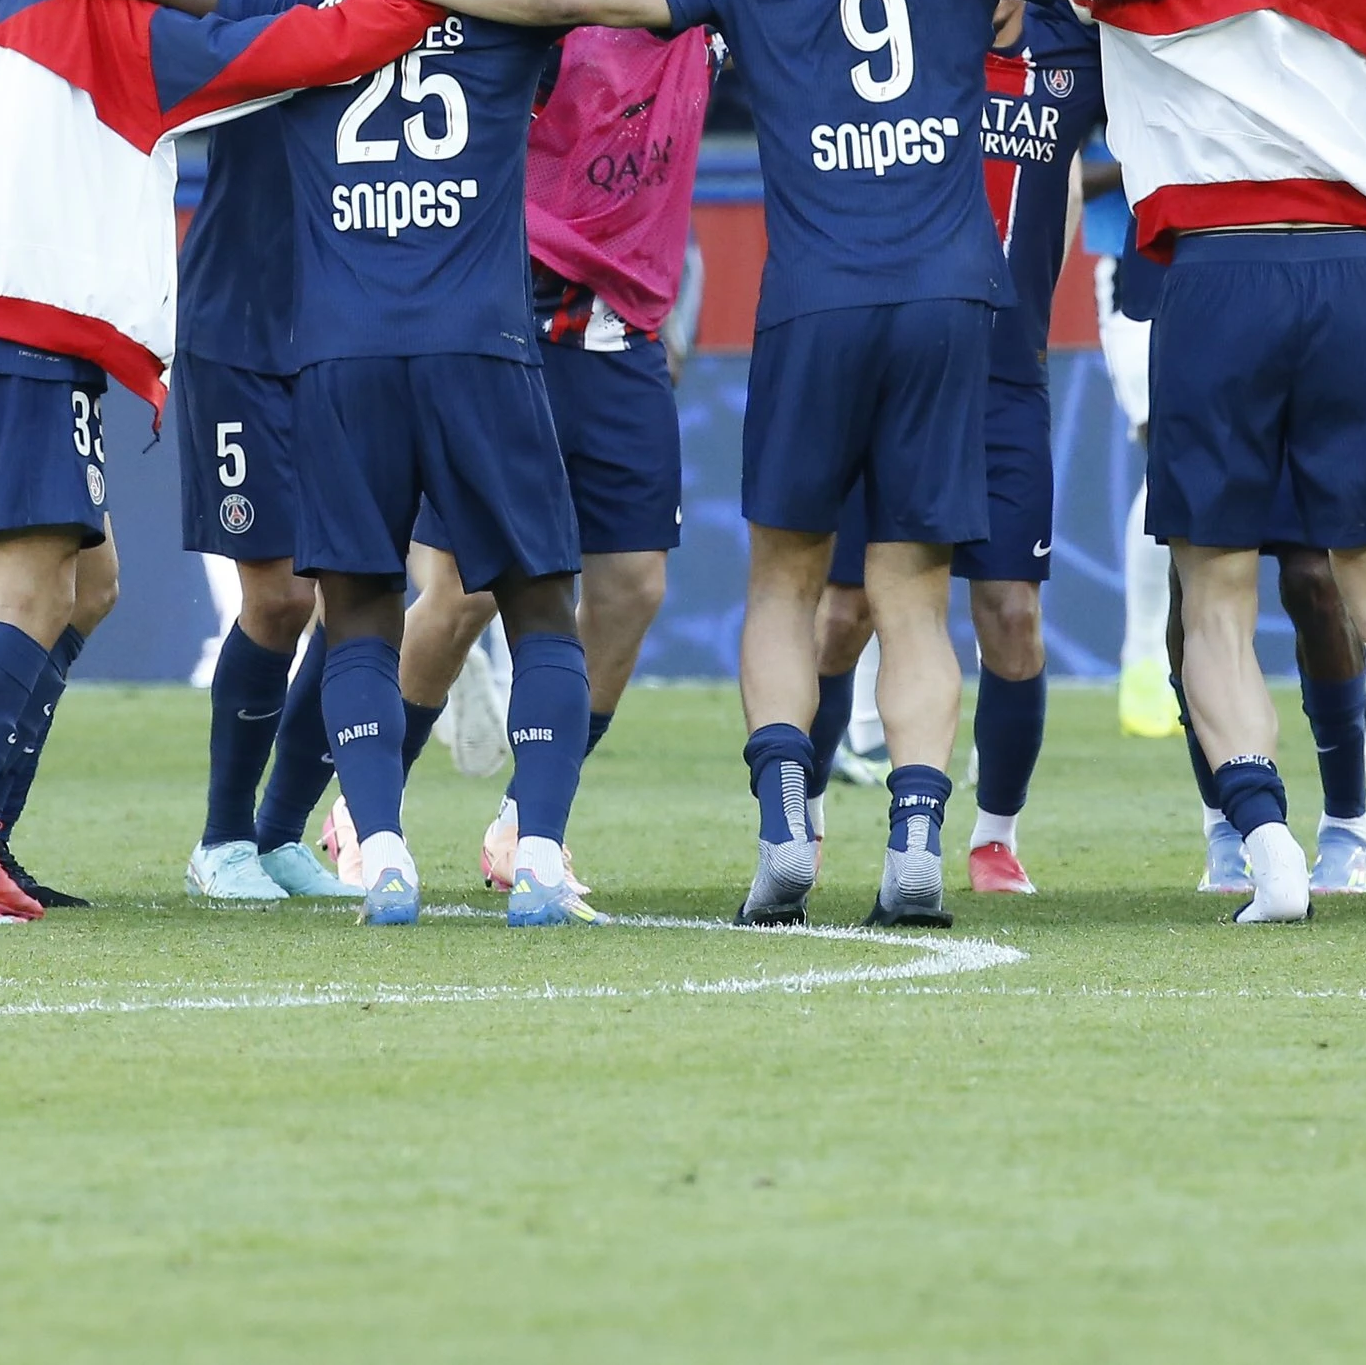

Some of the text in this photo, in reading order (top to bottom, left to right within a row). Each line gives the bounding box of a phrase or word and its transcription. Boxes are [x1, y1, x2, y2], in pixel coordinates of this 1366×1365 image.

[337, 49, 469, 163] 25
[811, 117, 947, 176] snipes
[333, 181, 461, 237] snipes
[217, 422, 246, 487] 5
[337, 722, 379, 746] PARIS
[512, 727, 553, 745] PARIS
